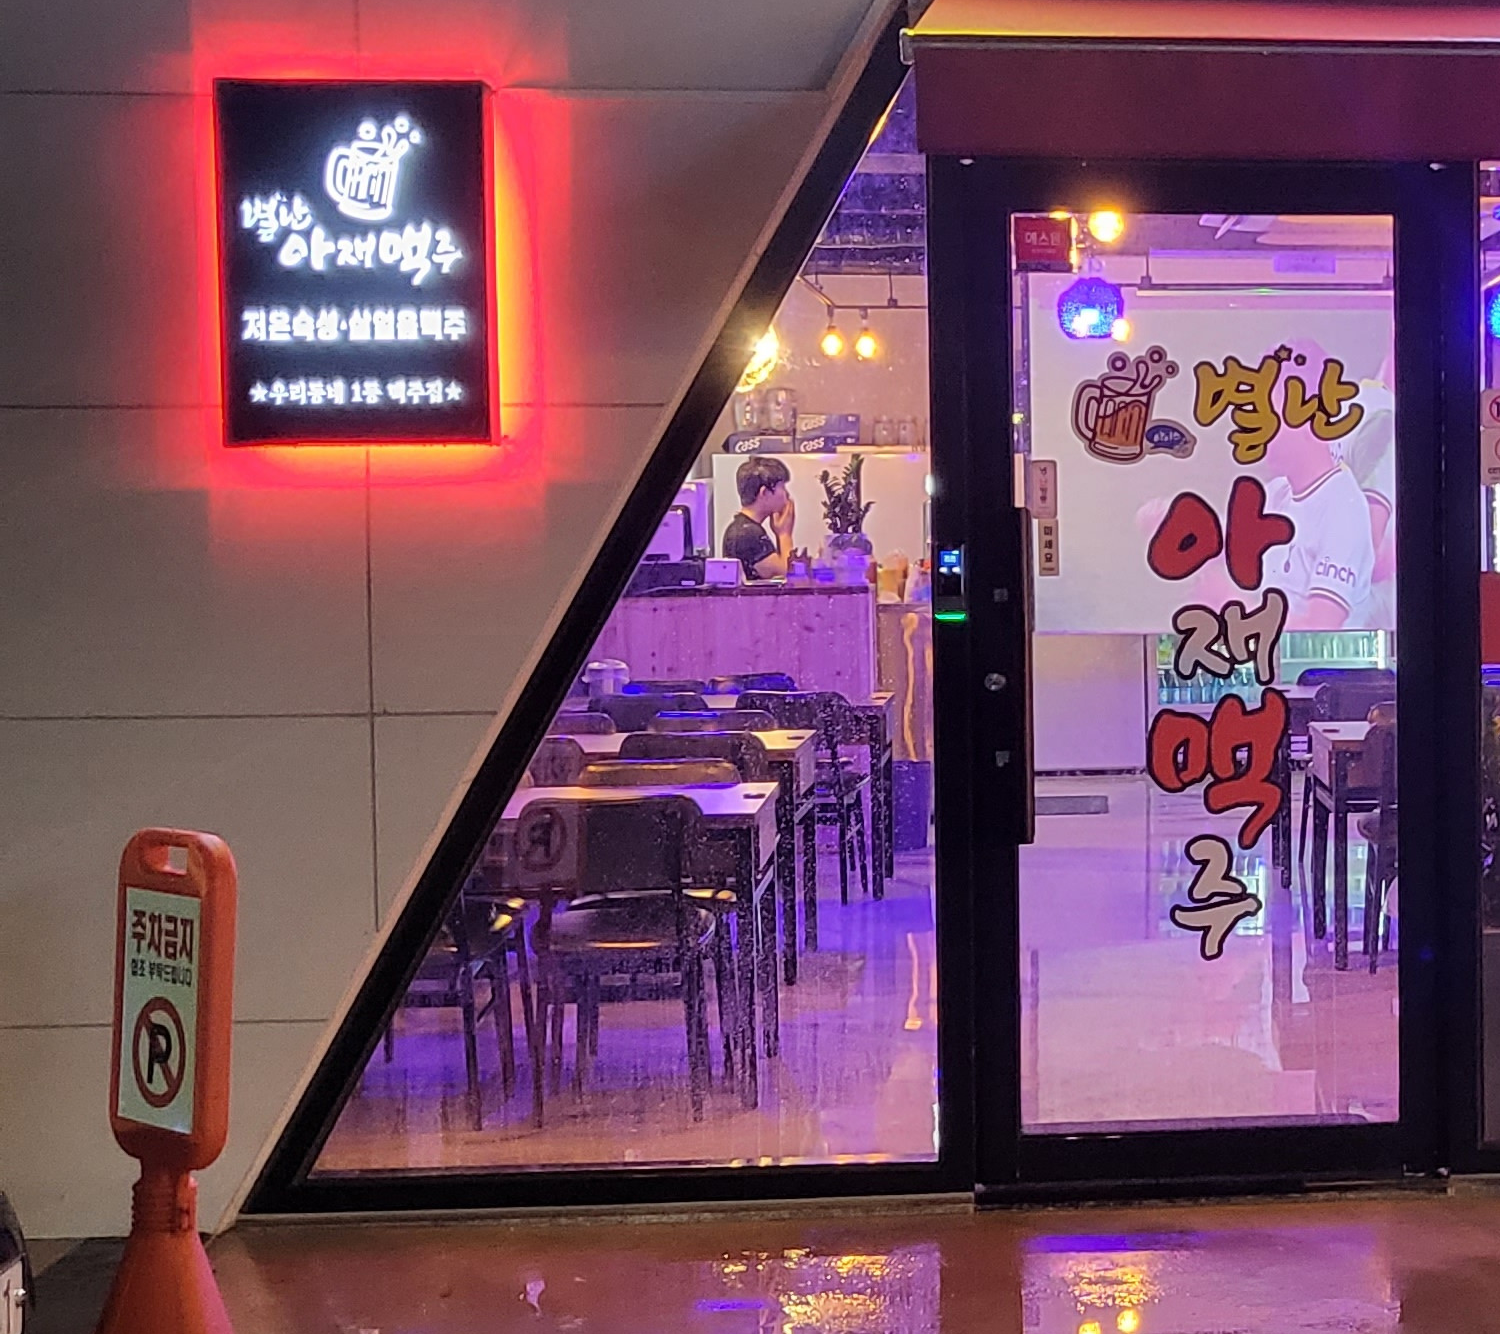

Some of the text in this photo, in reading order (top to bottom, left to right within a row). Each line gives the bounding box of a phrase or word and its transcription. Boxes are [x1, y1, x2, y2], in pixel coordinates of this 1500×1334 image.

[241, 192, 311, 243] 별난
[1193, 355, 1364, 465] 별난
[1315, 556, 1357, 588] cinch
[131, 909, 195, 965] 주차금지
